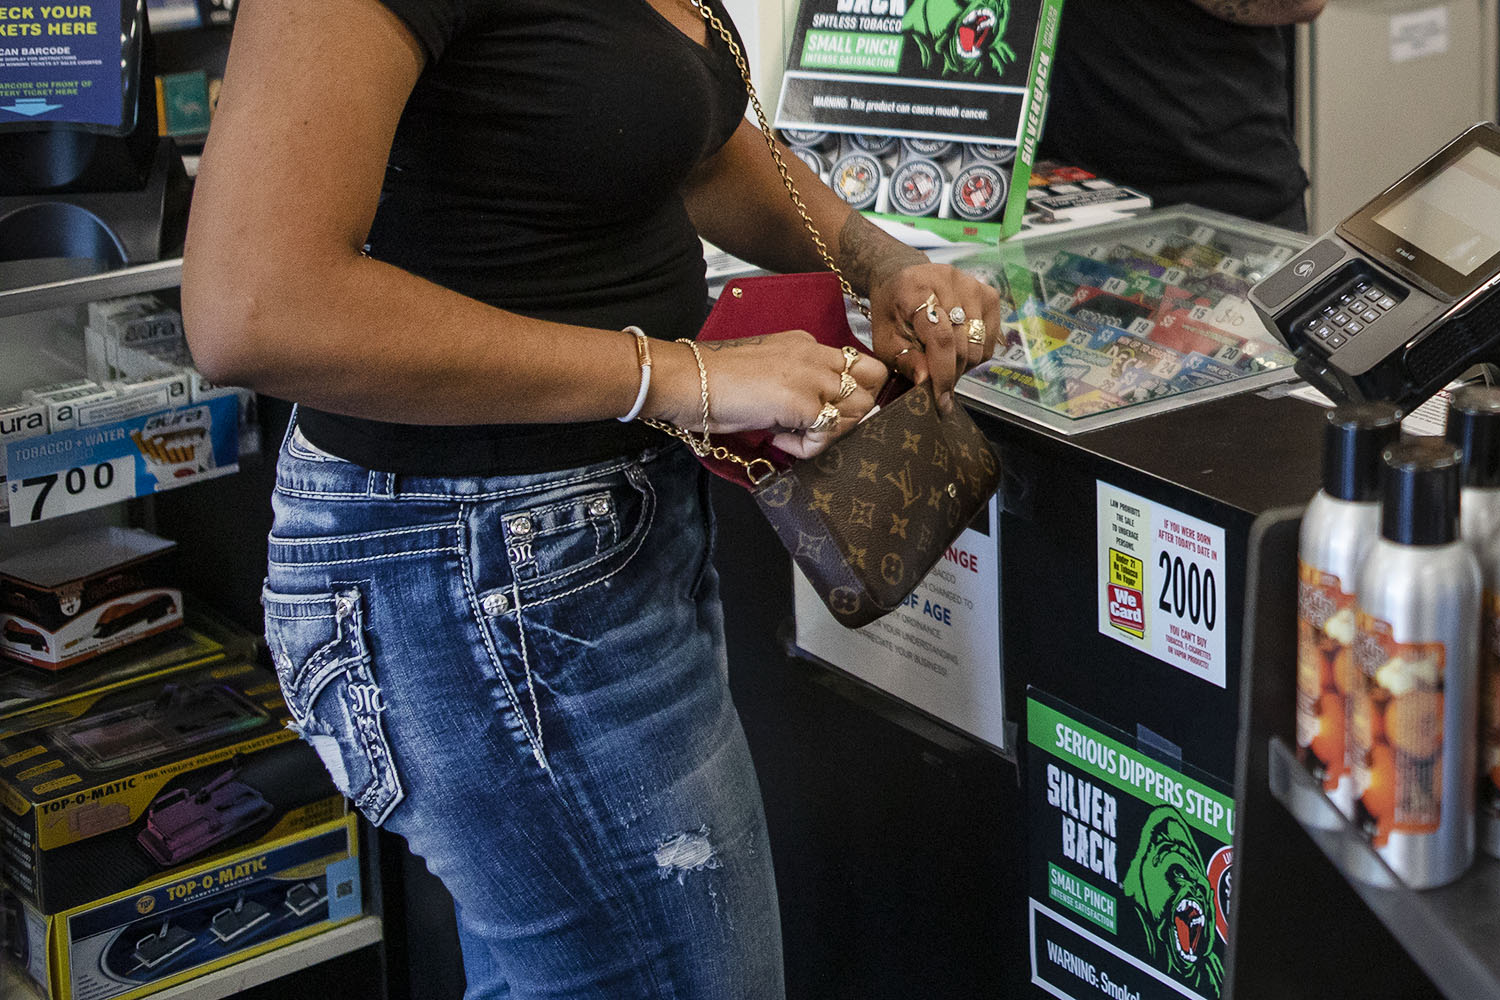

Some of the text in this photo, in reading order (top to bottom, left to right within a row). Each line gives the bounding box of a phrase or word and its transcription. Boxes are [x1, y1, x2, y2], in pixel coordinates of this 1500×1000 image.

[40, 5, 93, 20] YOUR
[812, 13, 902, 33] SPITLESS TOBACCO
[47, 22, 98, 36] HERE
[21, 46, 71, 56] BARCODE
[807, 33, 899, 56] SMALL PINCH
[812, 95, 849, 110] WARNING:
[849, 98, 865, 110] This
[865, 100, 896, 114] product
[896, 103, 910, 114] can
[911, 105, 934, 116] cause
[935, 105, 959, 118] mouth
[1020, 50, 1051, 167] SILVERBACK
[1222, 347, 1238, 360] 20
[14, 428, 126, 463] TOBACCO WATER
[1158, 528, 1175, 544] AFTER
[1181, 525, 1196, 540] WERE
[1196, 531, 1212, 546] BORN
[1113, 587, 1137, 608] We
[1158, 549, 1217, 632] 2000
[922, 599, 953, 628] AGE
[1110, 600, 1143, 624] Card
[1169, 623, 1208, 649] YOU CAN'T BUY
[1055, 721, 1225, 829] SERIOUS DIPPERS STEP
[42, 776, 137, 816] TOP-O-MATIC
[1046, 762, 1118, 838] SILVER
[1061, 813, 1118, 885] BACK
[165, 856, 268, 902] TOP-O-MATIC
[1050, 867, 1115, 918] SMALL PINCH
[1046, 938, 1100, 989] WARNING:
